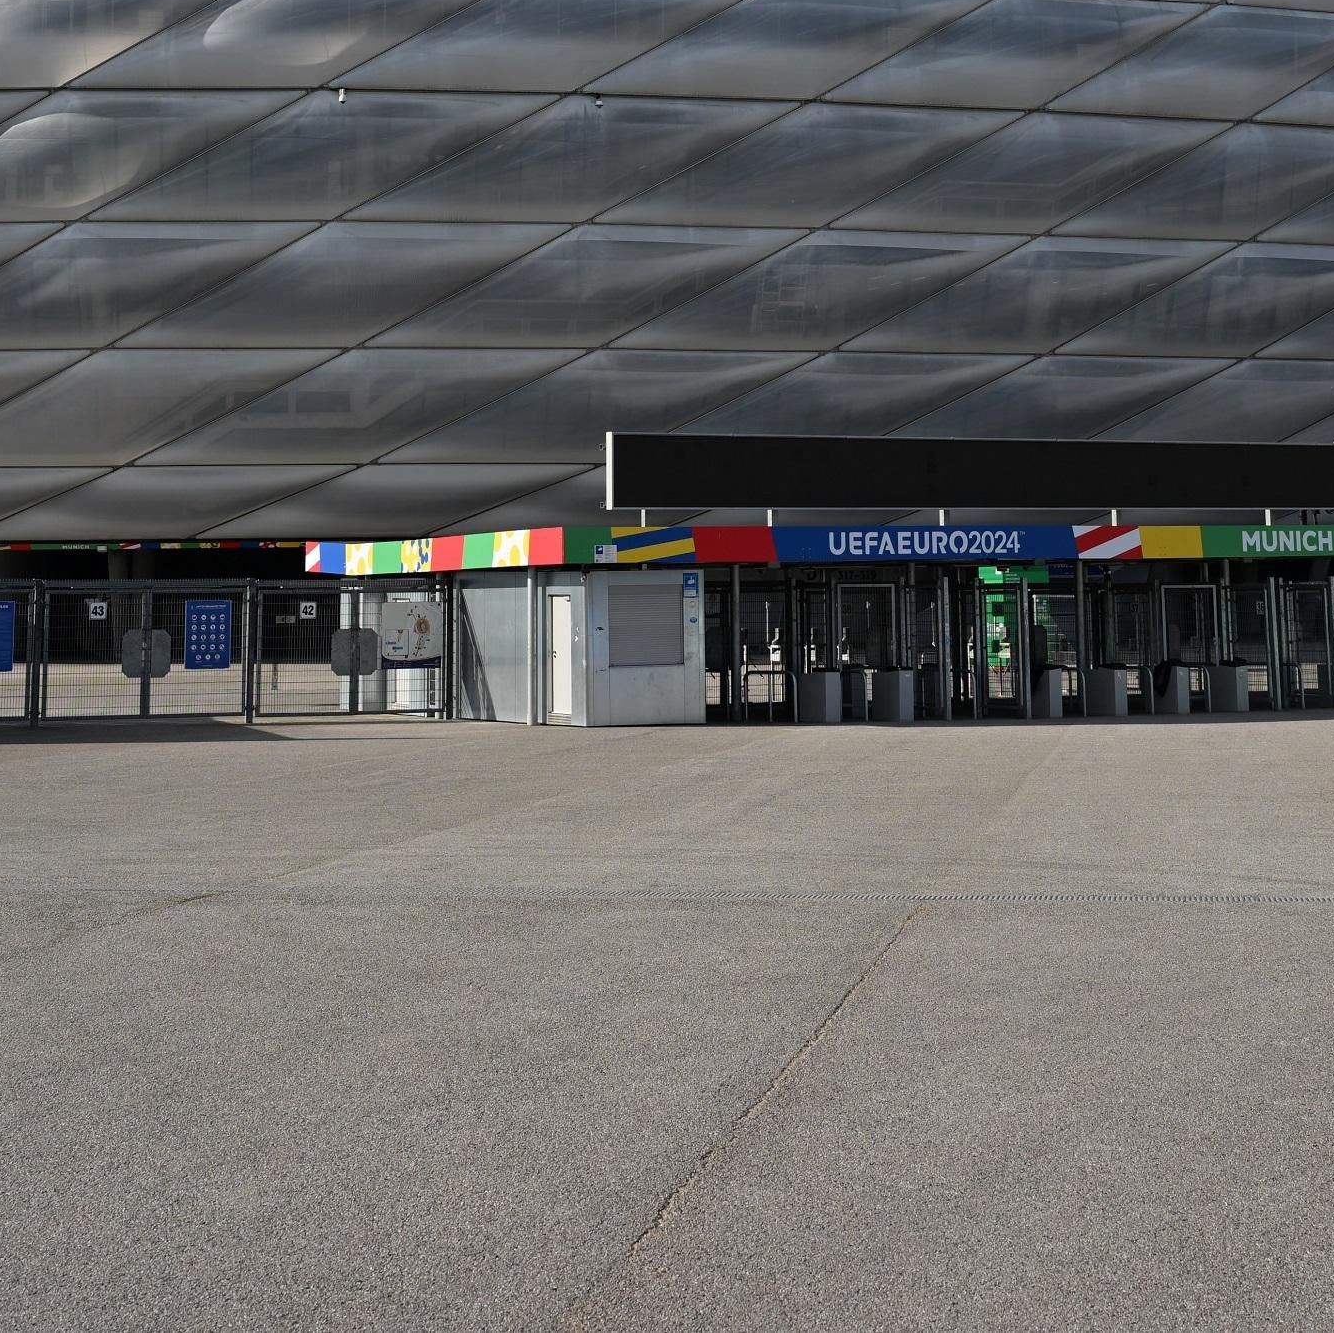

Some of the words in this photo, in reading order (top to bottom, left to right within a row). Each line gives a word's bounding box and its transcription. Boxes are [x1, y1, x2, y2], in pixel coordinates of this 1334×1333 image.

[1241, 530, 1334, 553] MUNICH
[91, 605, 104, 617] 43
[302, 605, 314, 617] 42
